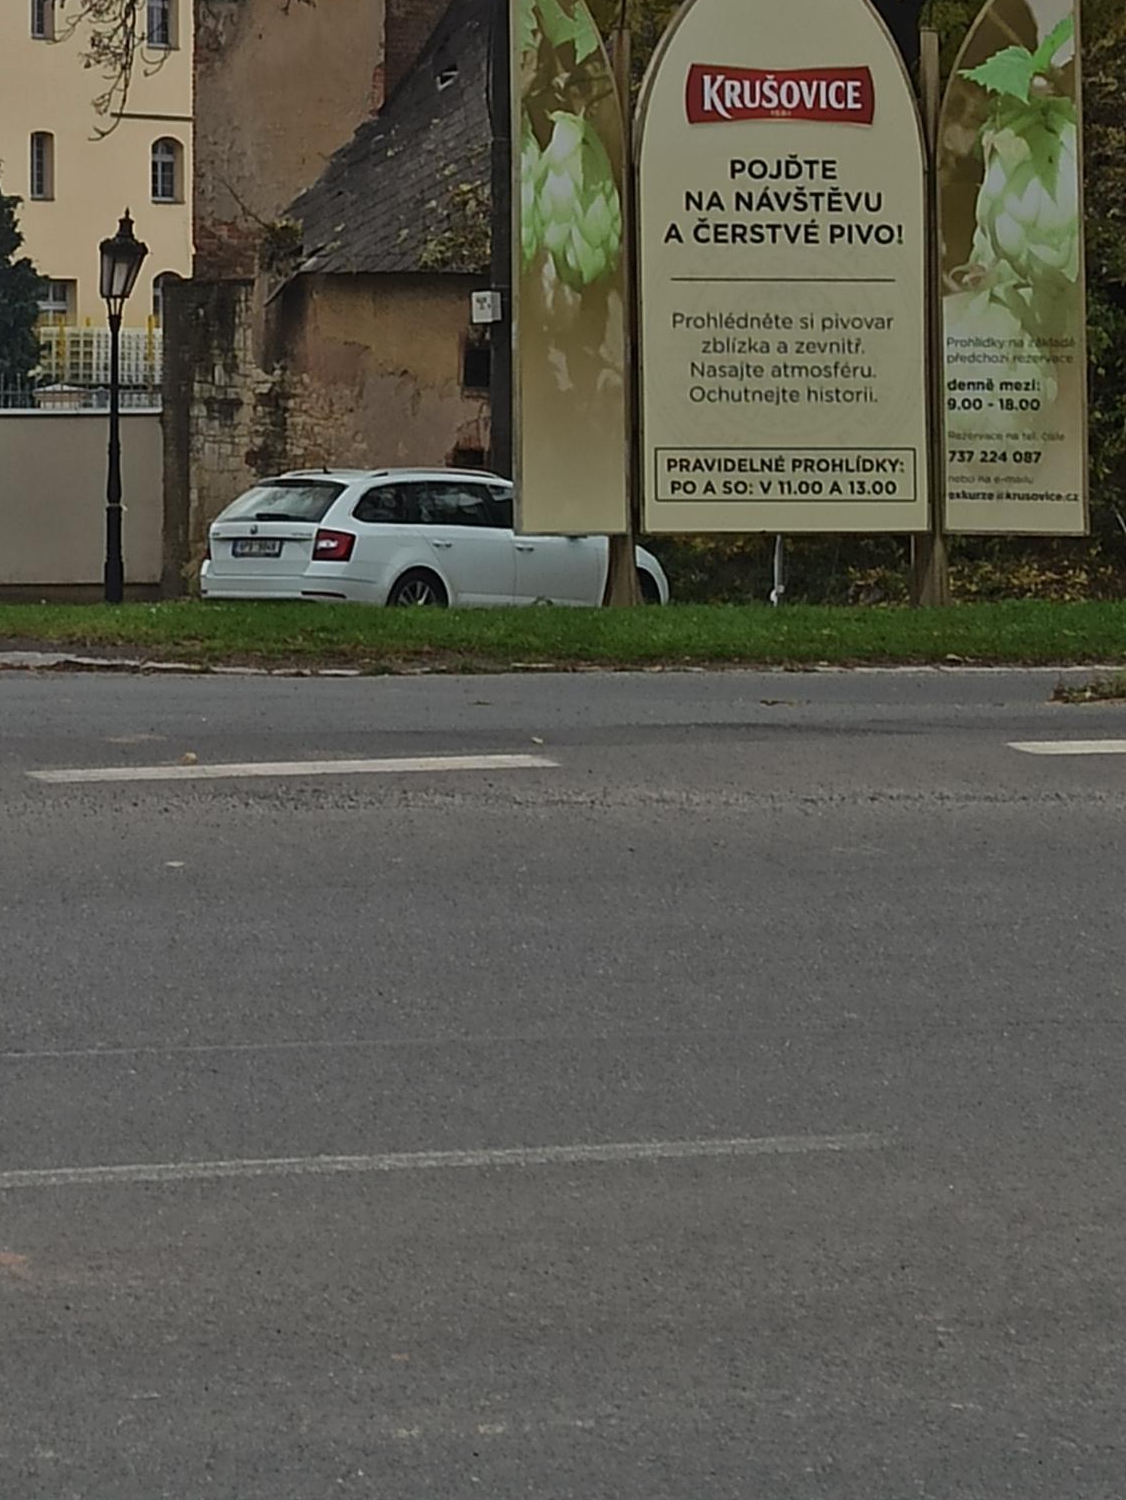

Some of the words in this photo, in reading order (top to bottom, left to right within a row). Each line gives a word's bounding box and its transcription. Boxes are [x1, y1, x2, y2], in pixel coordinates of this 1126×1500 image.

[702, 74, 862, 119] KRUŠOVICE
[730, 155, 837, 180] POJĎTE
[685, 192, 725, 212] NA
[735, 186, 882, 212] NÁVŠTĚVU
[664, 224, 683, 243] A
[693, 218, 819, 244] ČERSTVÉ
[830, 225, 903, 244] PIVO!
[672, 313, 793, 329] Prohlédněte
[800, 313, 814, 329] si
[821, 313, 893, 332] pivovar
[702, 338, 770, 354] zblízka
[777, 342, 788, 354] a
[795, 338, 865, 354] zevnitř.
[691, 363, 764, 380] Nasajte
[771, 362, 876, 378] atmosféru.
[947, 379, 994, 391] denně
[999, 380, 1040, 391] mezi:
[689, 386, 800, 405] Ochutnejte
[807, 387, 878, 403] historii.
[947, 399, 983, 410] 9.00
[1000, 399, 1040, 410] 18.00
[666, 456, 786, 472] PRAVIDELNÉ
[791, 456, 905, 473] PROHLÍDKY:
[948, 451, 974, 463] 737
[980, 451, 1007, 463] 224
[1012, 451, 1042, 463] 087
[671, 480, 696, 495] PO
[703, 480, 716, 495] A
[722, 480, 753, 495] SO:
[760, 480, 772, 495] V
[778, 481, 823, 495] 11.00
[829, 481, 842, 495] A
[849, 481, 897, 495] 13.00
